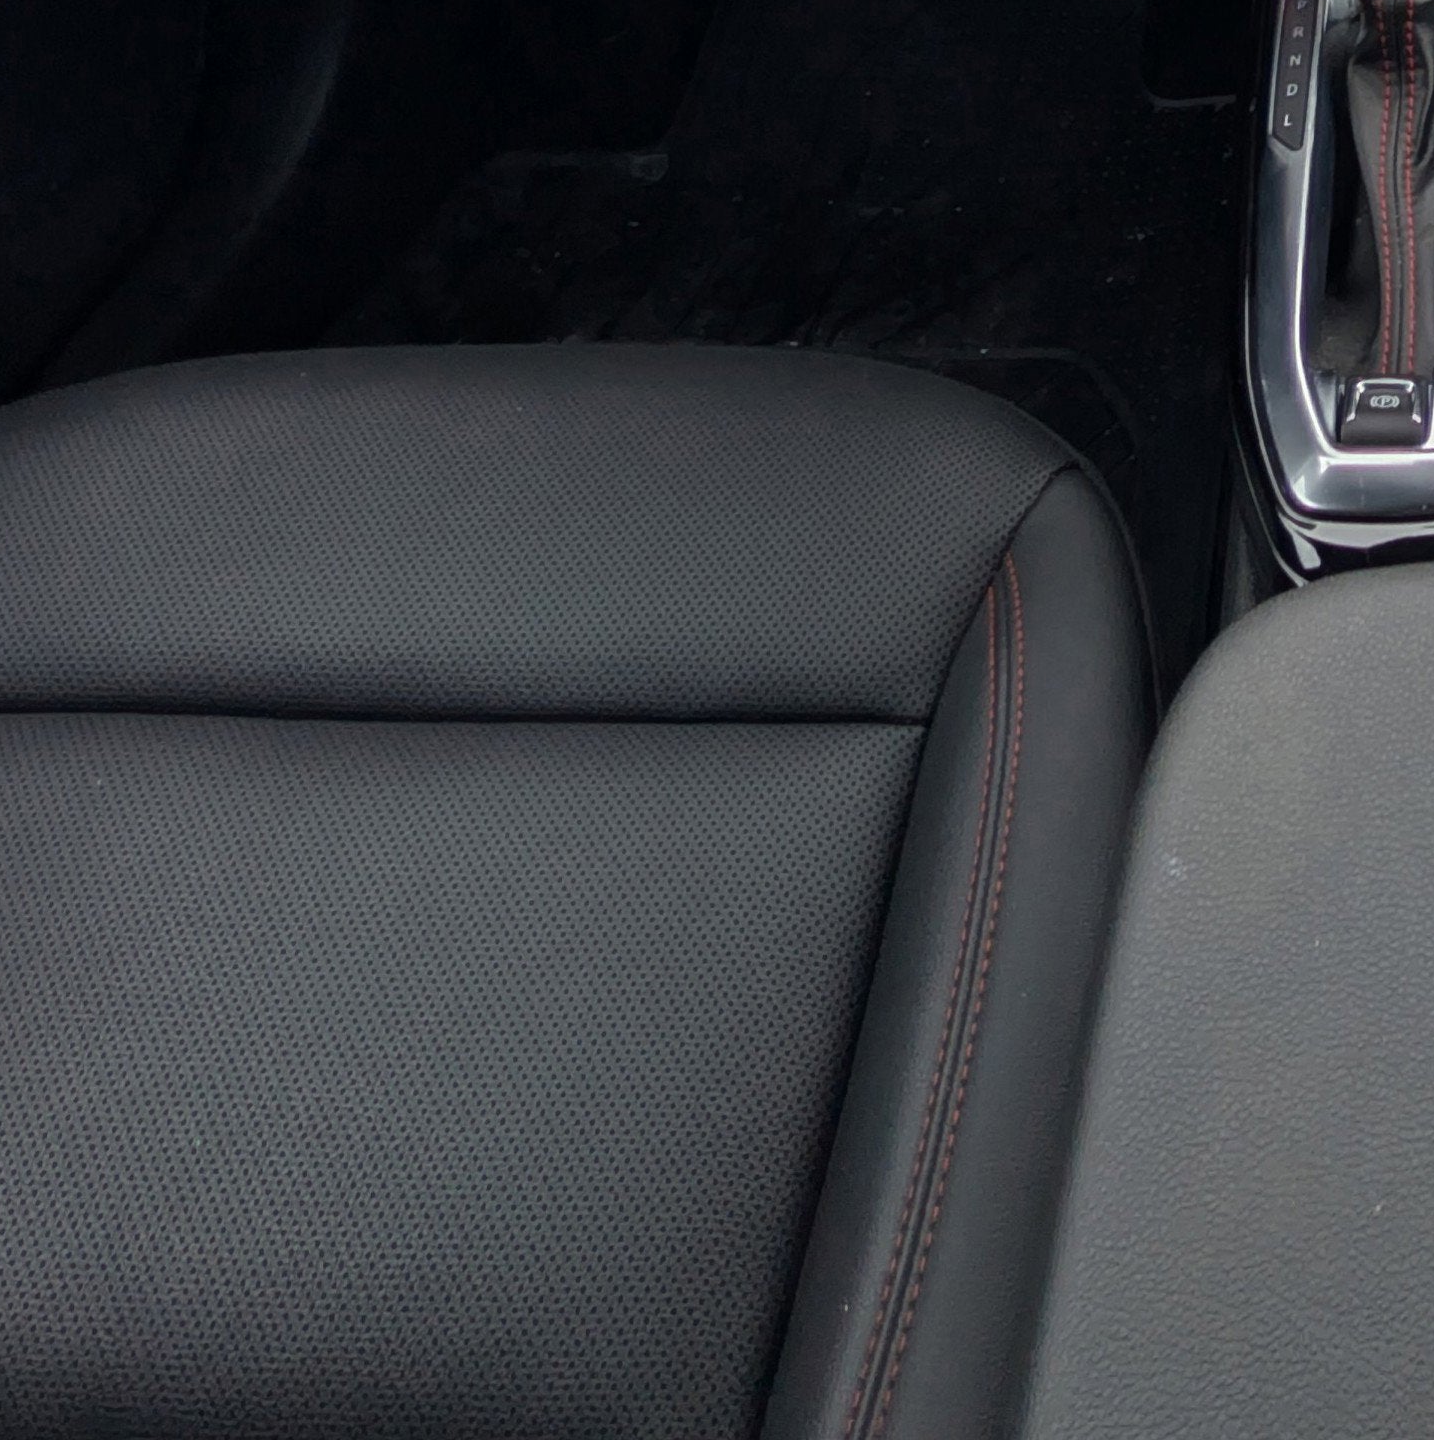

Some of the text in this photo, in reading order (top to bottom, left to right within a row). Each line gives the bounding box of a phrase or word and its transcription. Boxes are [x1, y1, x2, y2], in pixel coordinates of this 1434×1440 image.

[1292, 26, 1305, 38] R
[1289, 53, 1302, 67] N
[1286, 83, 1299, 97] D
[1283, 114, 1293, 127] L
